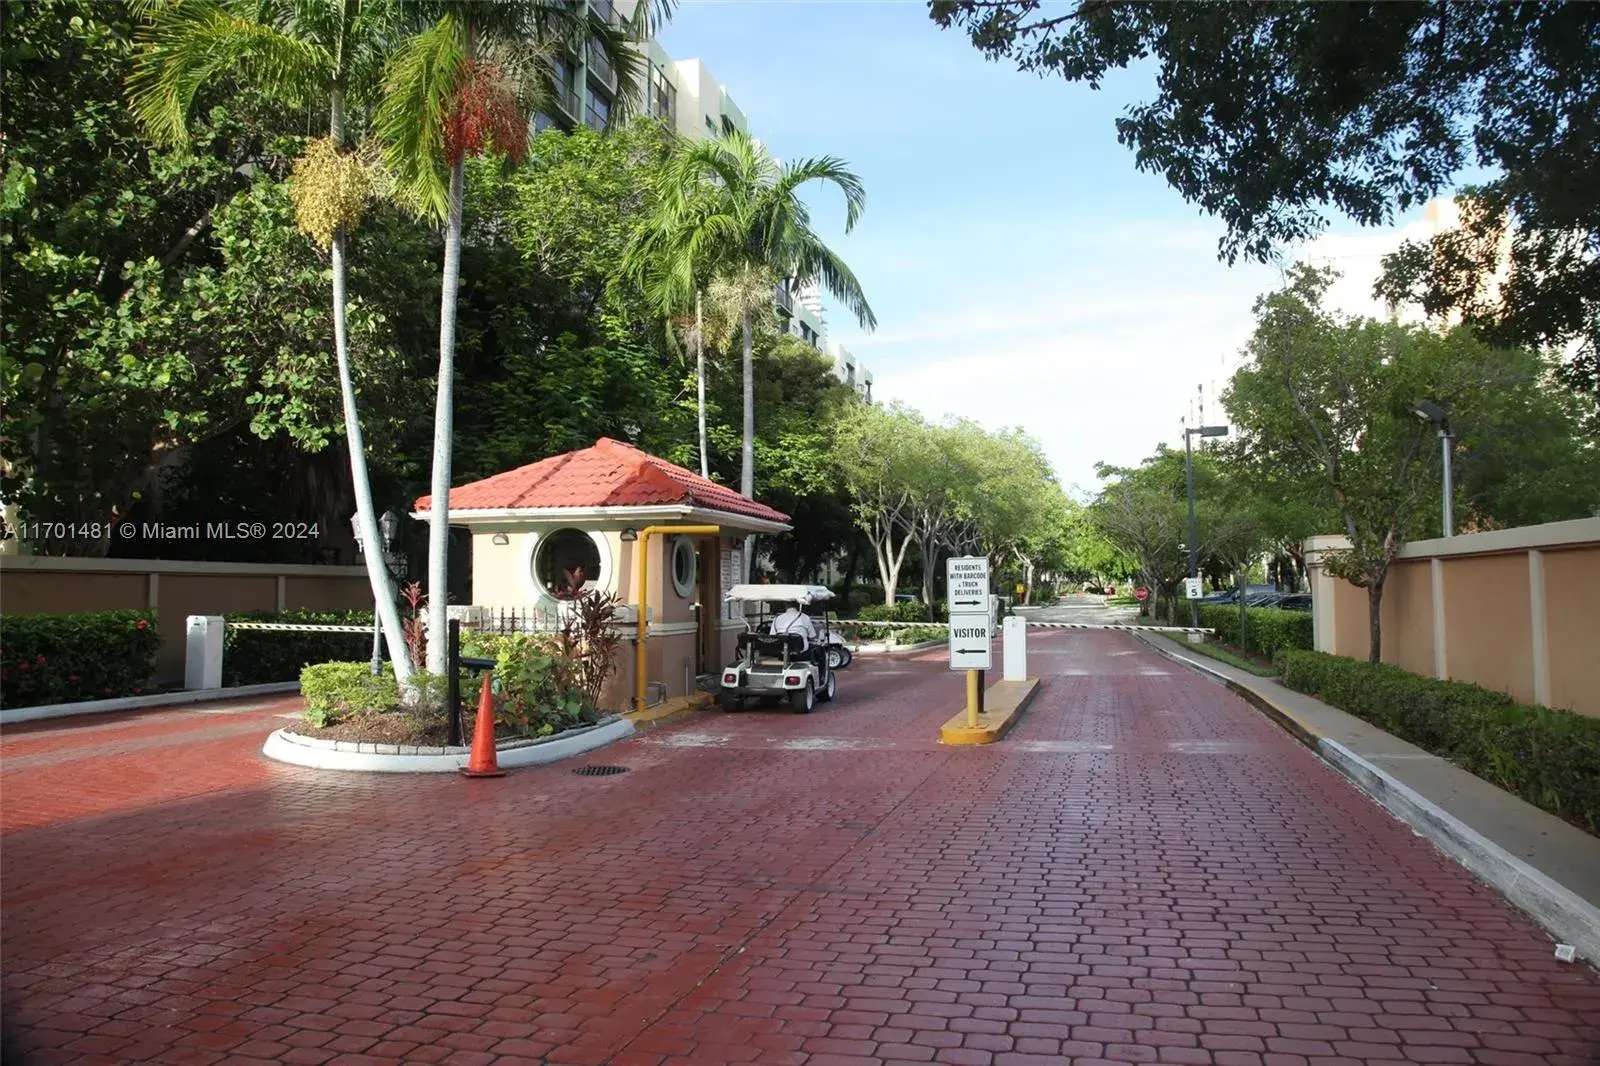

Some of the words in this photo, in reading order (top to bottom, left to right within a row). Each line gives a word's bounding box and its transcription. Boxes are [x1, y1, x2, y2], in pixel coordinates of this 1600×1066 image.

[963, 571, 986, 579] BARCODE
[1191, 588, 1198, 596] 5
[953, 628, 986, 638] VISITOR
